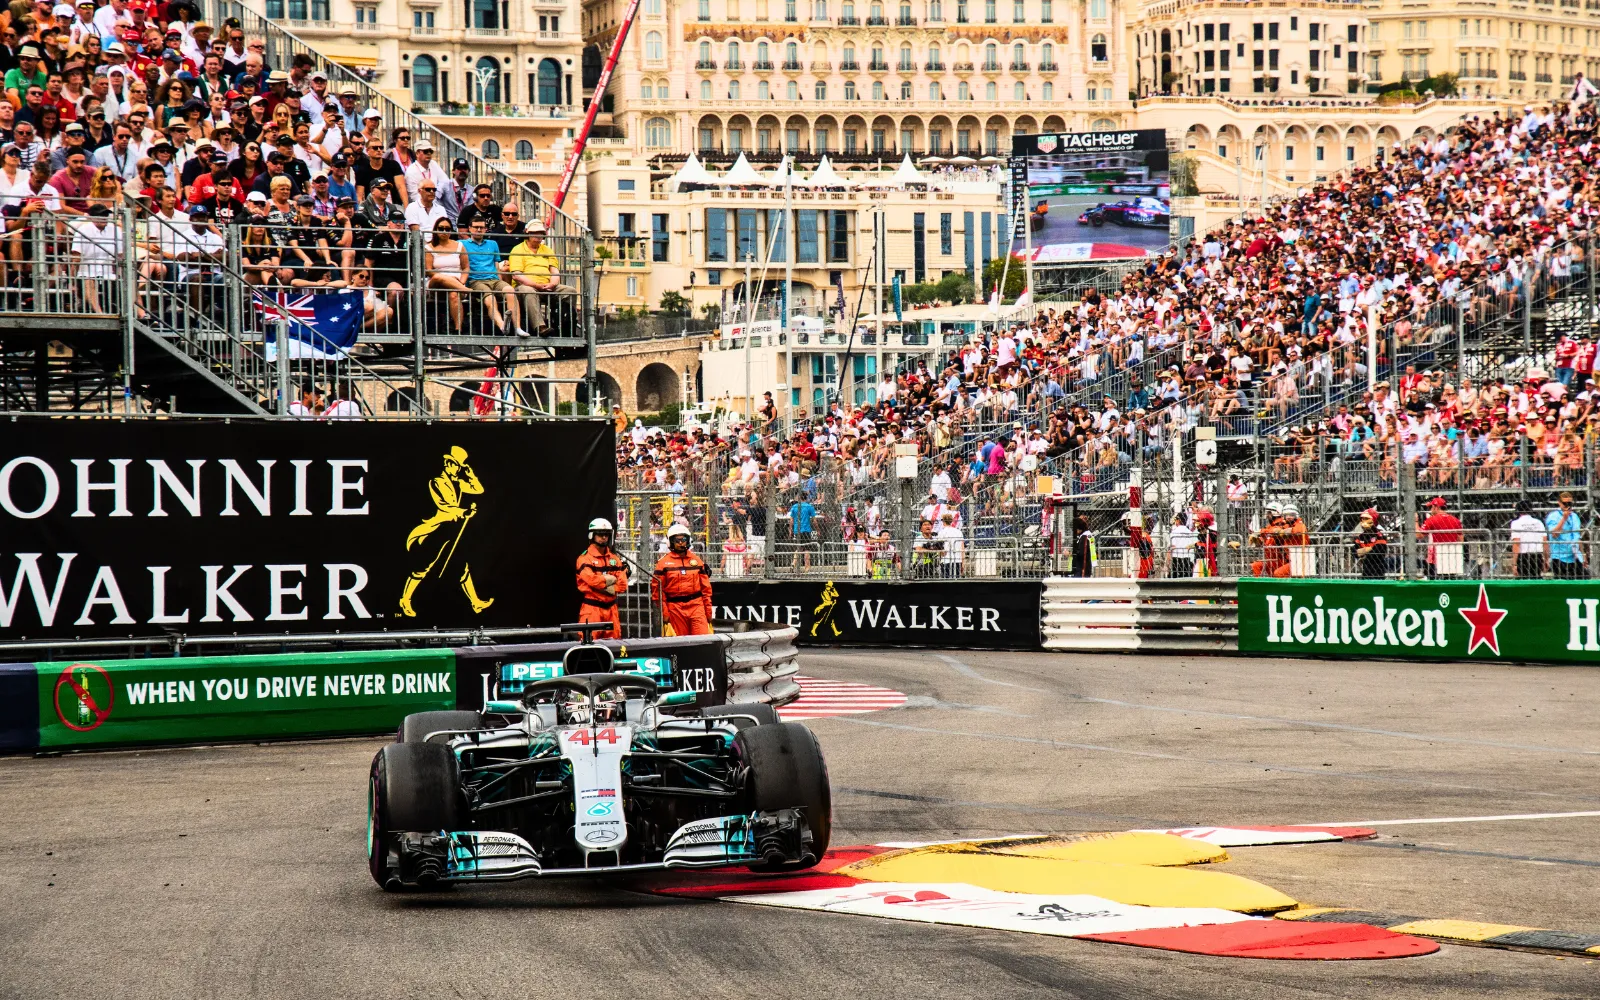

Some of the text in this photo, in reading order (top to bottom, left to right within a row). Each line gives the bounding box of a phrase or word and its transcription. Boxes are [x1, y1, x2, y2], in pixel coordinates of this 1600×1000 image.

[0, 456, 370, 519] OHNNIE
[0, 553, 371, 627] WALKER
[848, 600, 1001, 631] WALKER
[1566, 599, 1600, 651] H
[125, 672, 452, 705] WHEN YOU DRIVE NEVER DRINK
[568, 727, 622, 746] 44
[684, 822, 718, 833] PETRONAS
